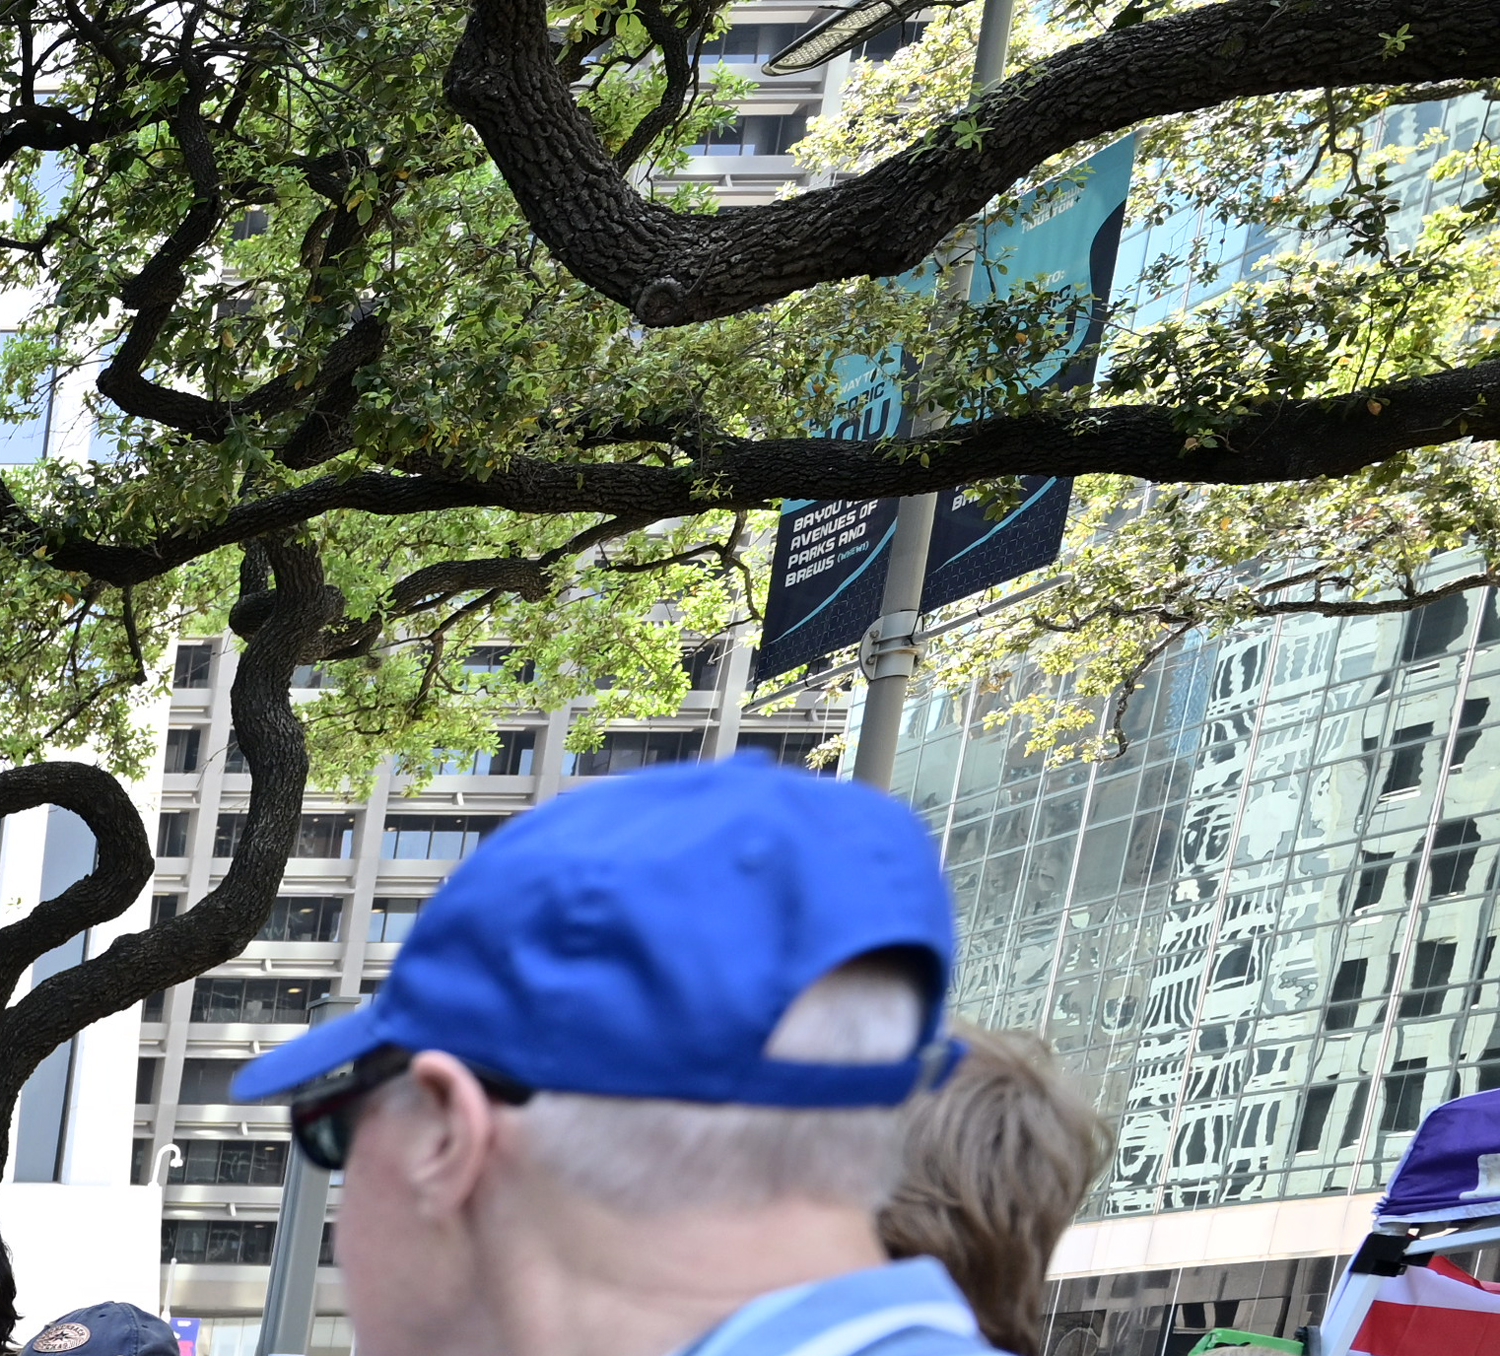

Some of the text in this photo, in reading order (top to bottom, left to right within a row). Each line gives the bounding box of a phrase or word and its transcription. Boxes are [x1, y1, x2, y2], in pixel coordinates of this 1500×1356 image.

[787, 522, 867, 570] PARKS AND
[790, 500, 878, 551] AVENUES OF
[784, 556, 835, 588] BREWS
